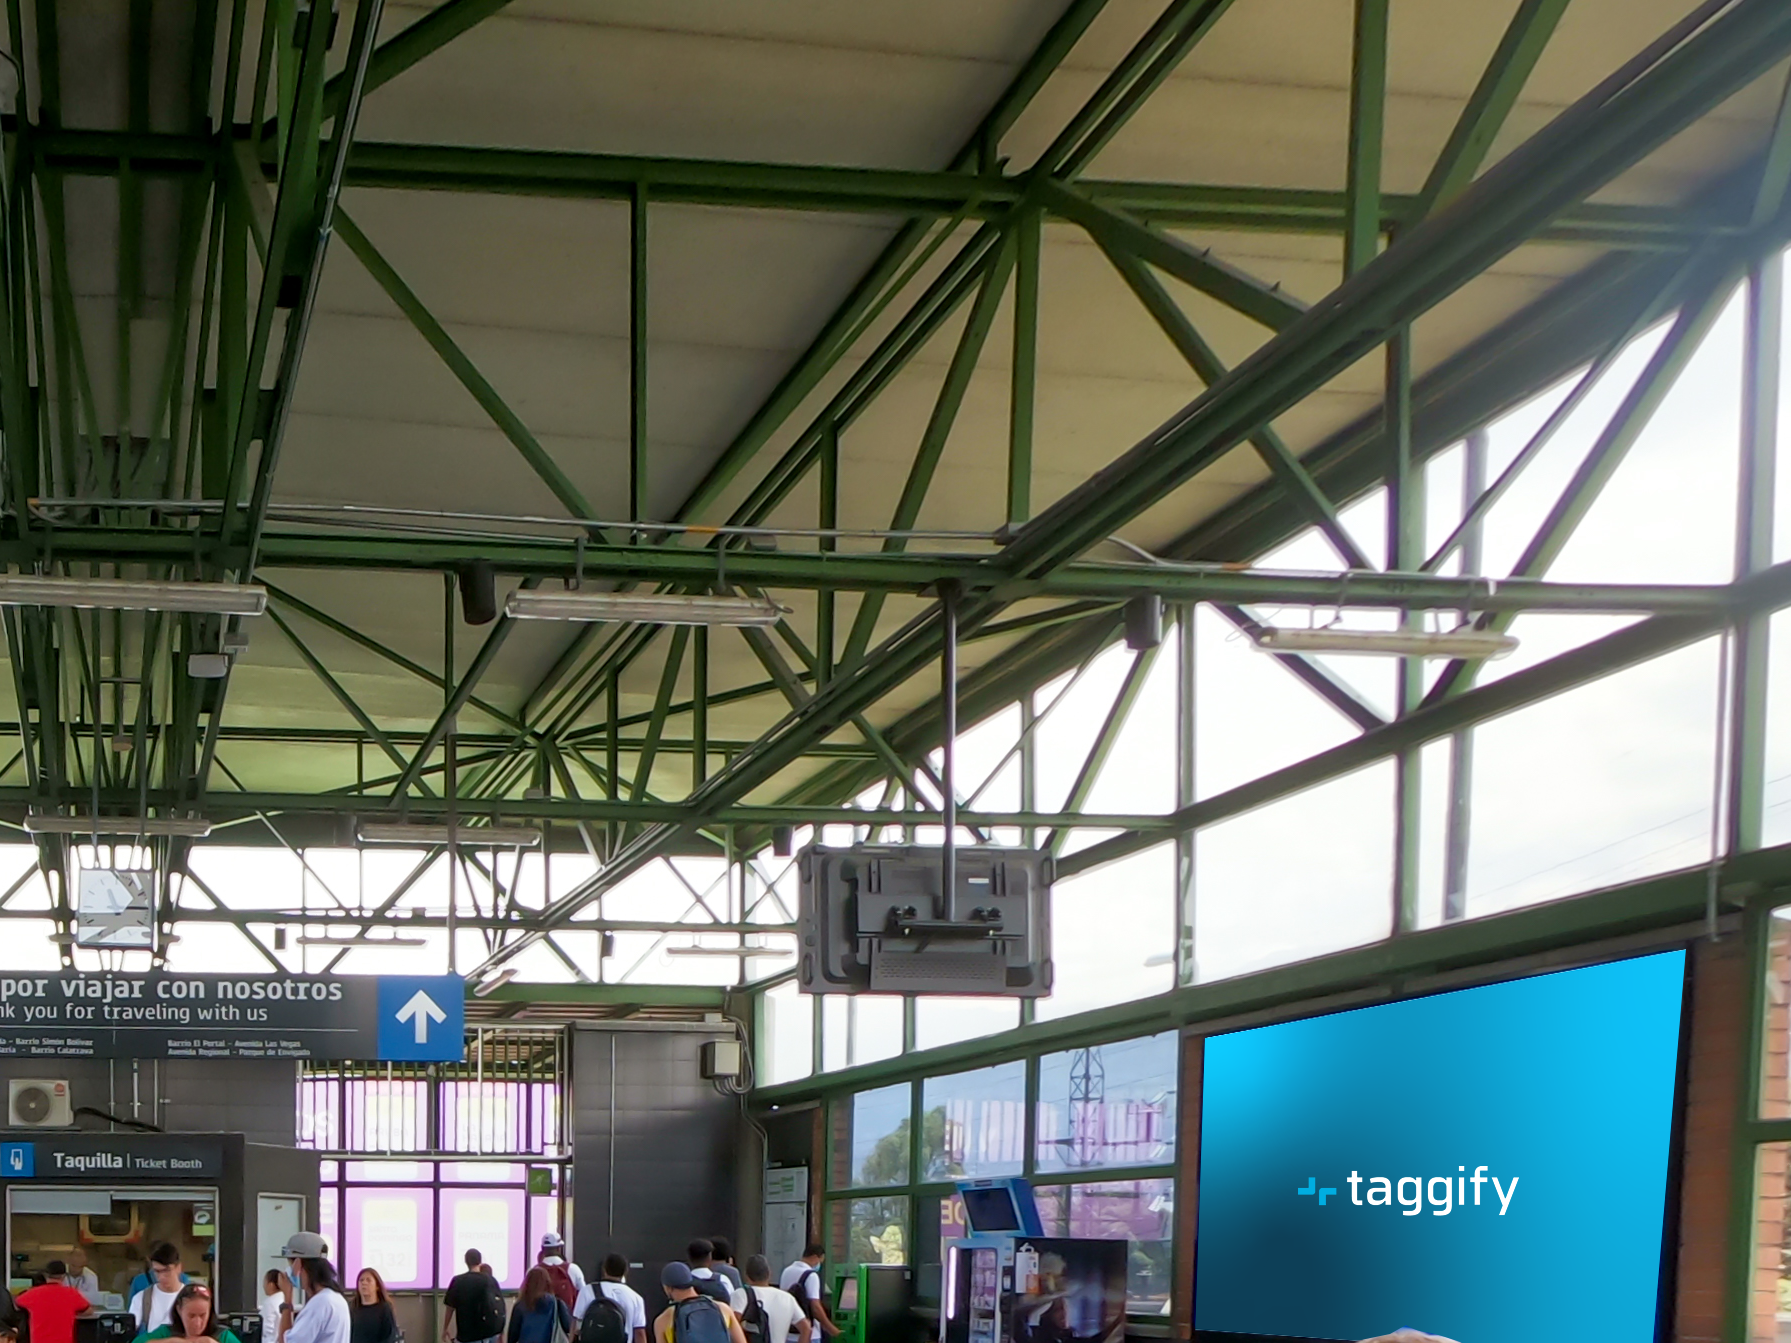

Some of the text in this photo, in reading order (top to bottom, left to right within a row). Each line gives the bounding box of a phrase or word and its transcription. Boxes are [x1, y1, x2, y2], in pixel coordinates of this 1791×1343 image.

[0, 978, 48, 1001] por
[60, 974, 145, 1002] viajar
[156, 980, 205, 998] con
[217, 979, 343, 1001] nosotros
[24, 1004, 58, 1022] you
[65, 1002, 95, 1019] for
[103, 1003, 190, 1023] traveling
[197, 1004, 240, 1021] with
[246, 1007, 268, 1021] us
[16, 1037, 40, 1045] Barrio
[31, 1046, 55, 1054] Barrio
[168, 1039, 192, 1047] Barrio
[53, 1152, 202, 1172] Taquilla Ticket Booth
[1346, 1165, 1519, 1217] taggify
